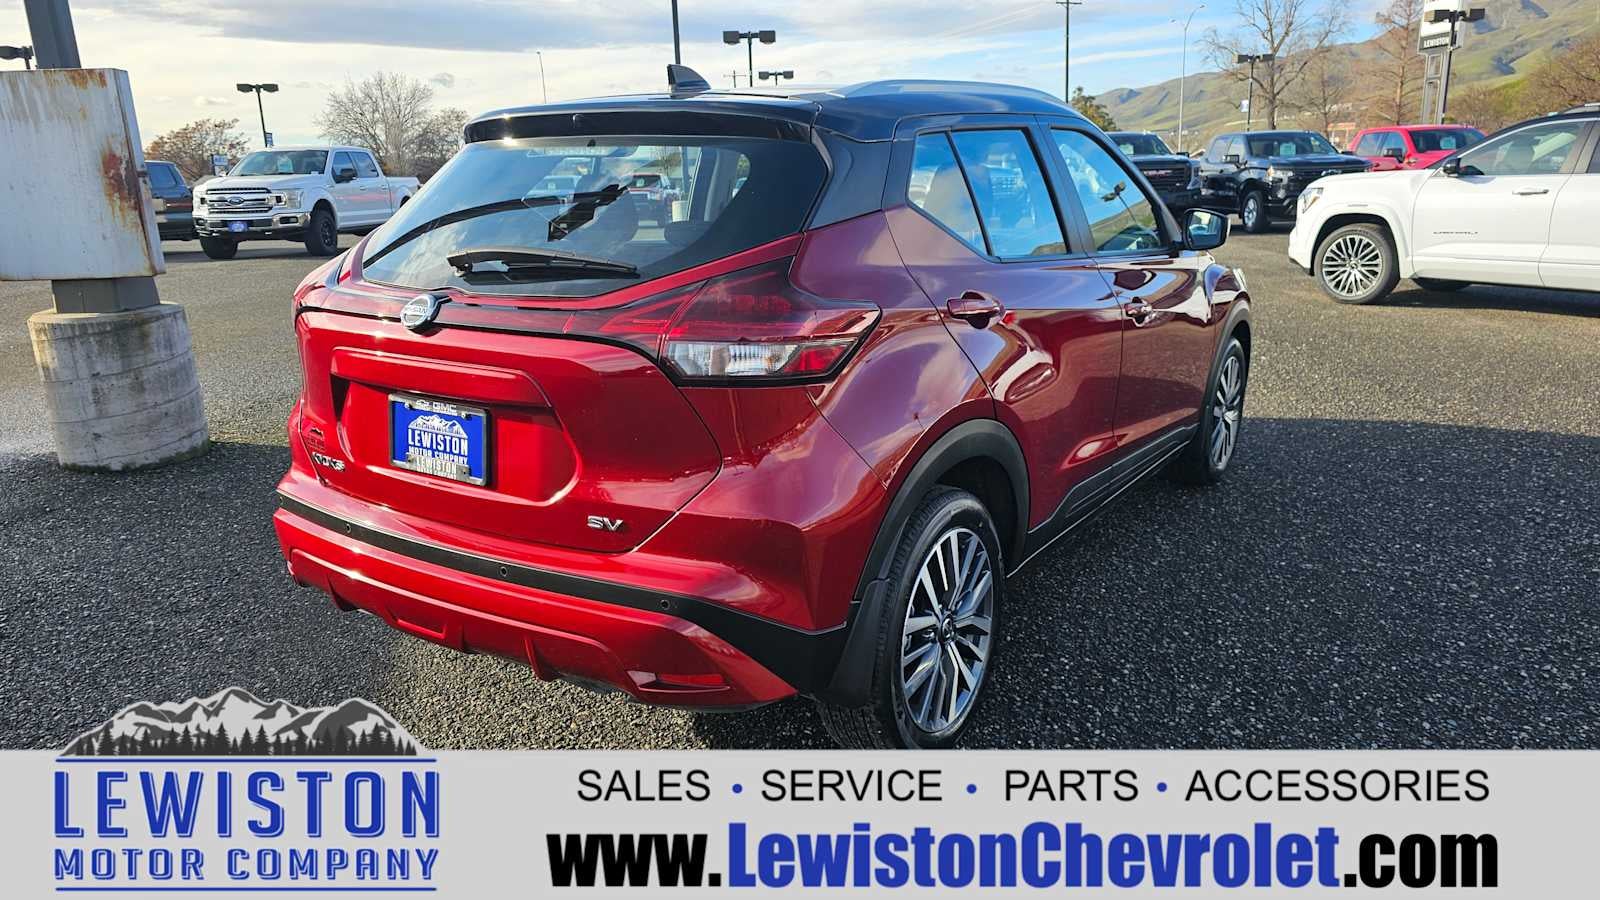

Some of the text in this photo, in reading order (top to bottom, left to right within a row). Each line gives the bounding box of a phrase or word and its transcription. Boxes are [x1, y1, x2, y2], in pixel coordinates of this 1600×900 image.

[432, 401, 458, 412] GMC
[407, 428, 468, 456] LEWISTON
[408, 446, 468, 466] MOTOR COMPANY
[416, 456, 457, 474] LEWISTON
[587, 515, 623, 531] SV
